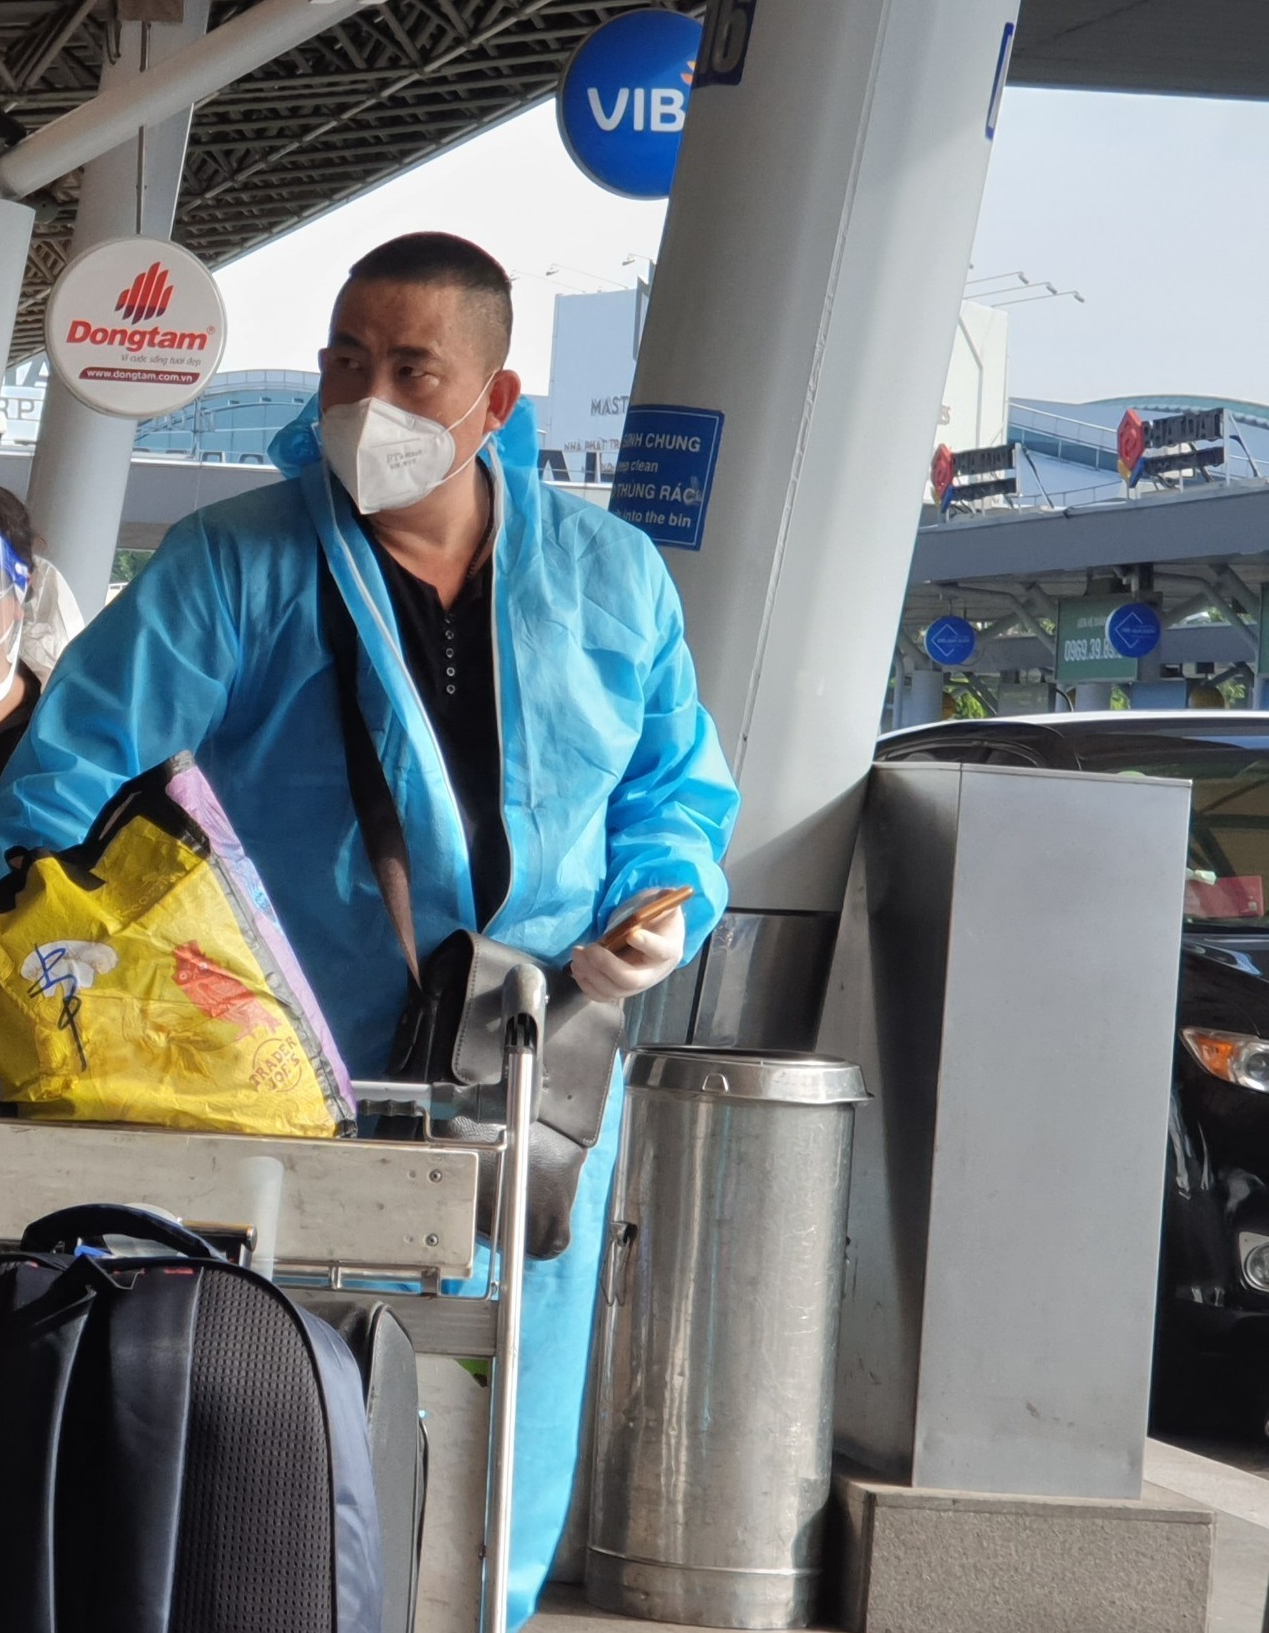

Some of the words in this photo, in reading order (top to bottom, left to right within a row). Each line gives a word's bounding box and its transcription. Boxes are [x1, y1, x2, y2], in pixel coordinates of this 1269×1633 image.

[587, 87, 686, 132] VIB
[66, 320, 208, 352] Dongtam
[86, 368, 193, 383] www.dongtam.com.vn
[645, 433, 701, 452] CHUNG
[630, 459, 659, 472] clean
[645, 511, 665, 524] the
[668, 513, 691, 528] bin
[249, 1036, 298, 1088] TRADER
